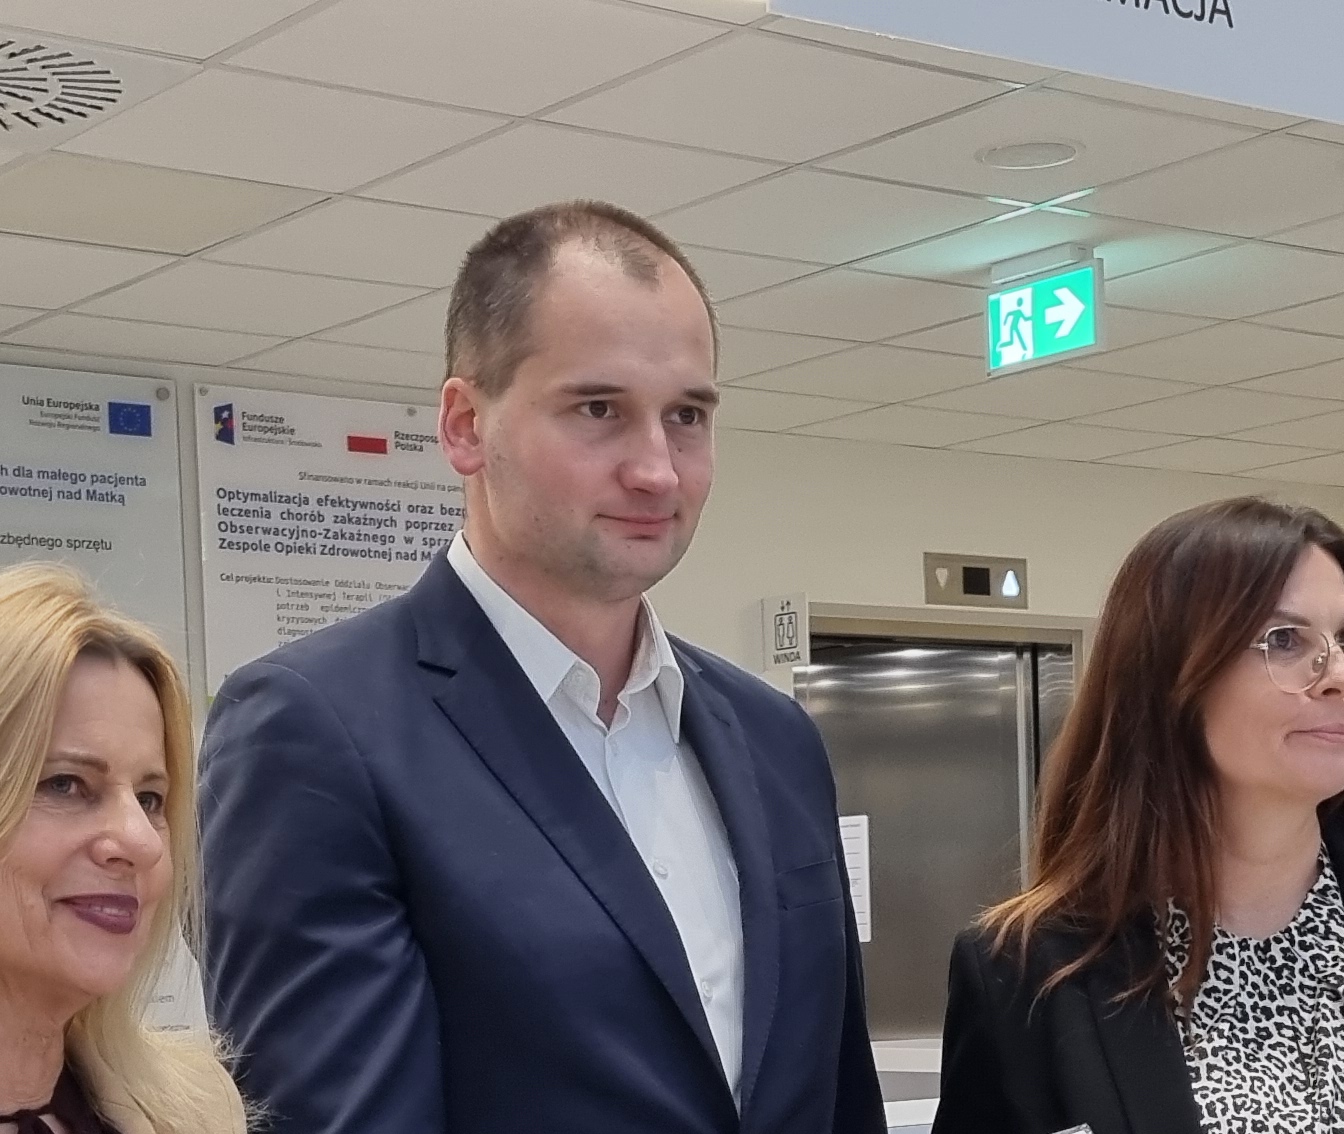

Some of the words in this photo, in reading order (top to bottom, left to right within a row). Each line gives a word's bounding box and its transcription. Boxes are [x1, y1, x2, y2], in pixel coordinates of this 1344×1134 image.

[22, 395, 45, 408] Unia
[46, 398, 100, 412] Europejska
[241, 411, 285, 424] Fundusze
[242, 422, 296, 437] Europejskie
[395, 441, 424, 452] Polska
[13, 466, 33, 479] dla
[37, 469, 87, 485] małego
[91, 473, 147, 488] pacjenta
[57, 488, 82, 501] nad
[87, 489, 126, 506] Matką
[216, 487, 309, 507] Optymalizacja
[316, 495, 401, 513] efektywności
[407, 504, 434, 515] oraz
[217, 504, 271, 520] leczenia
[280, 510, 325, 523] chorób
[333, 513, 398, 529] zakaźnych
[406, 520, 454, 533] poprzez
[218, 521, 396, 546] Obserwacyjno-Zakaźnego
[403, 535, 414, 545] w
[66, 538, 112, 552] sprzętu
[218, 538, 271, 554] Zespole
[274, 542, 317, 556] Opieki
[319, 545, 392, 562] Zdrowotnej
[396, 549, 417, 562] nad
[773, 651, 801, 664] WINDA
